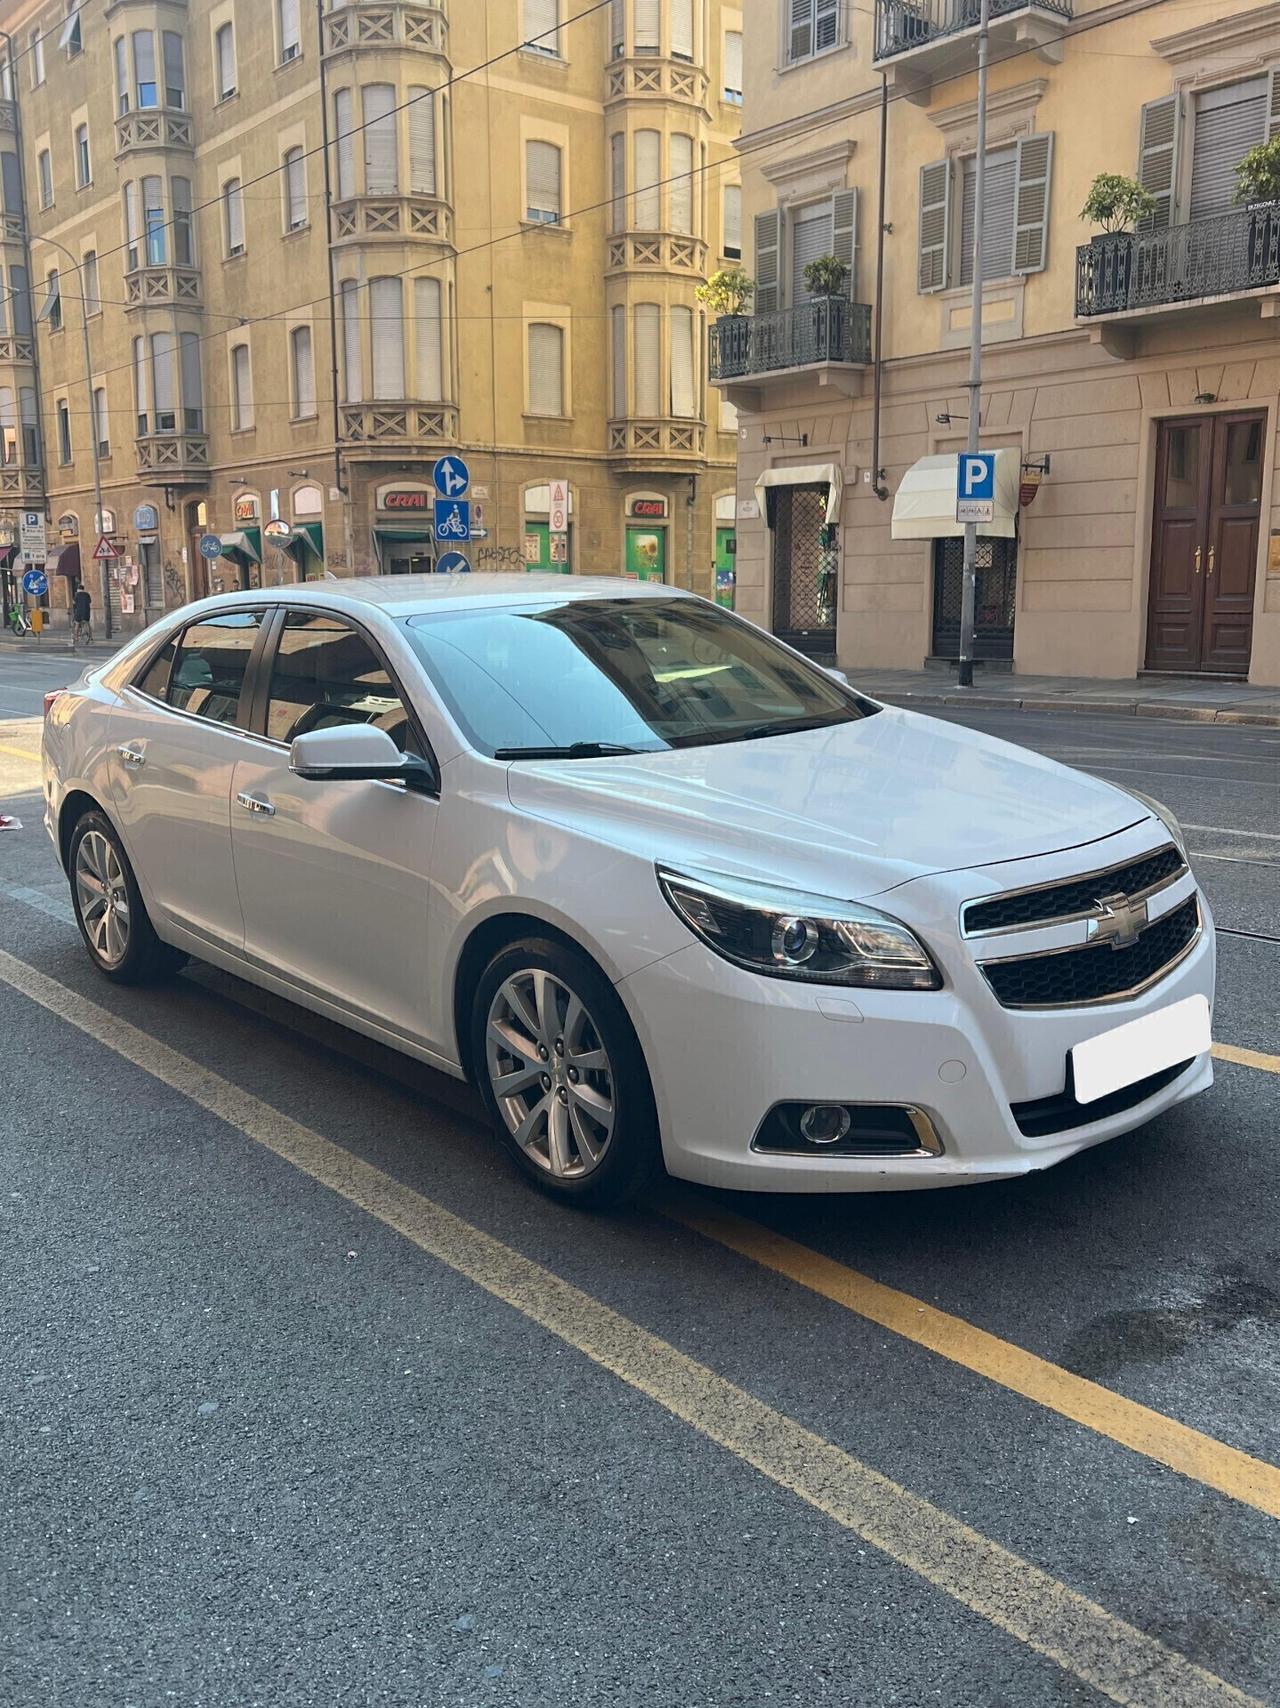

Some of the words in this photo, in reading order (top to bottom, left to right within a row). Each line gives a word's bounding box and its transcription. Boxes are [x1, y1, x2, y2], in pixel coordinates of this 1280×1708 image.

[964, 458, 988, 495] P
[386, 494, 425, 507] CRAI
[635, 501, 663, 514] CRAI
[27, 514, 36, 525] P
